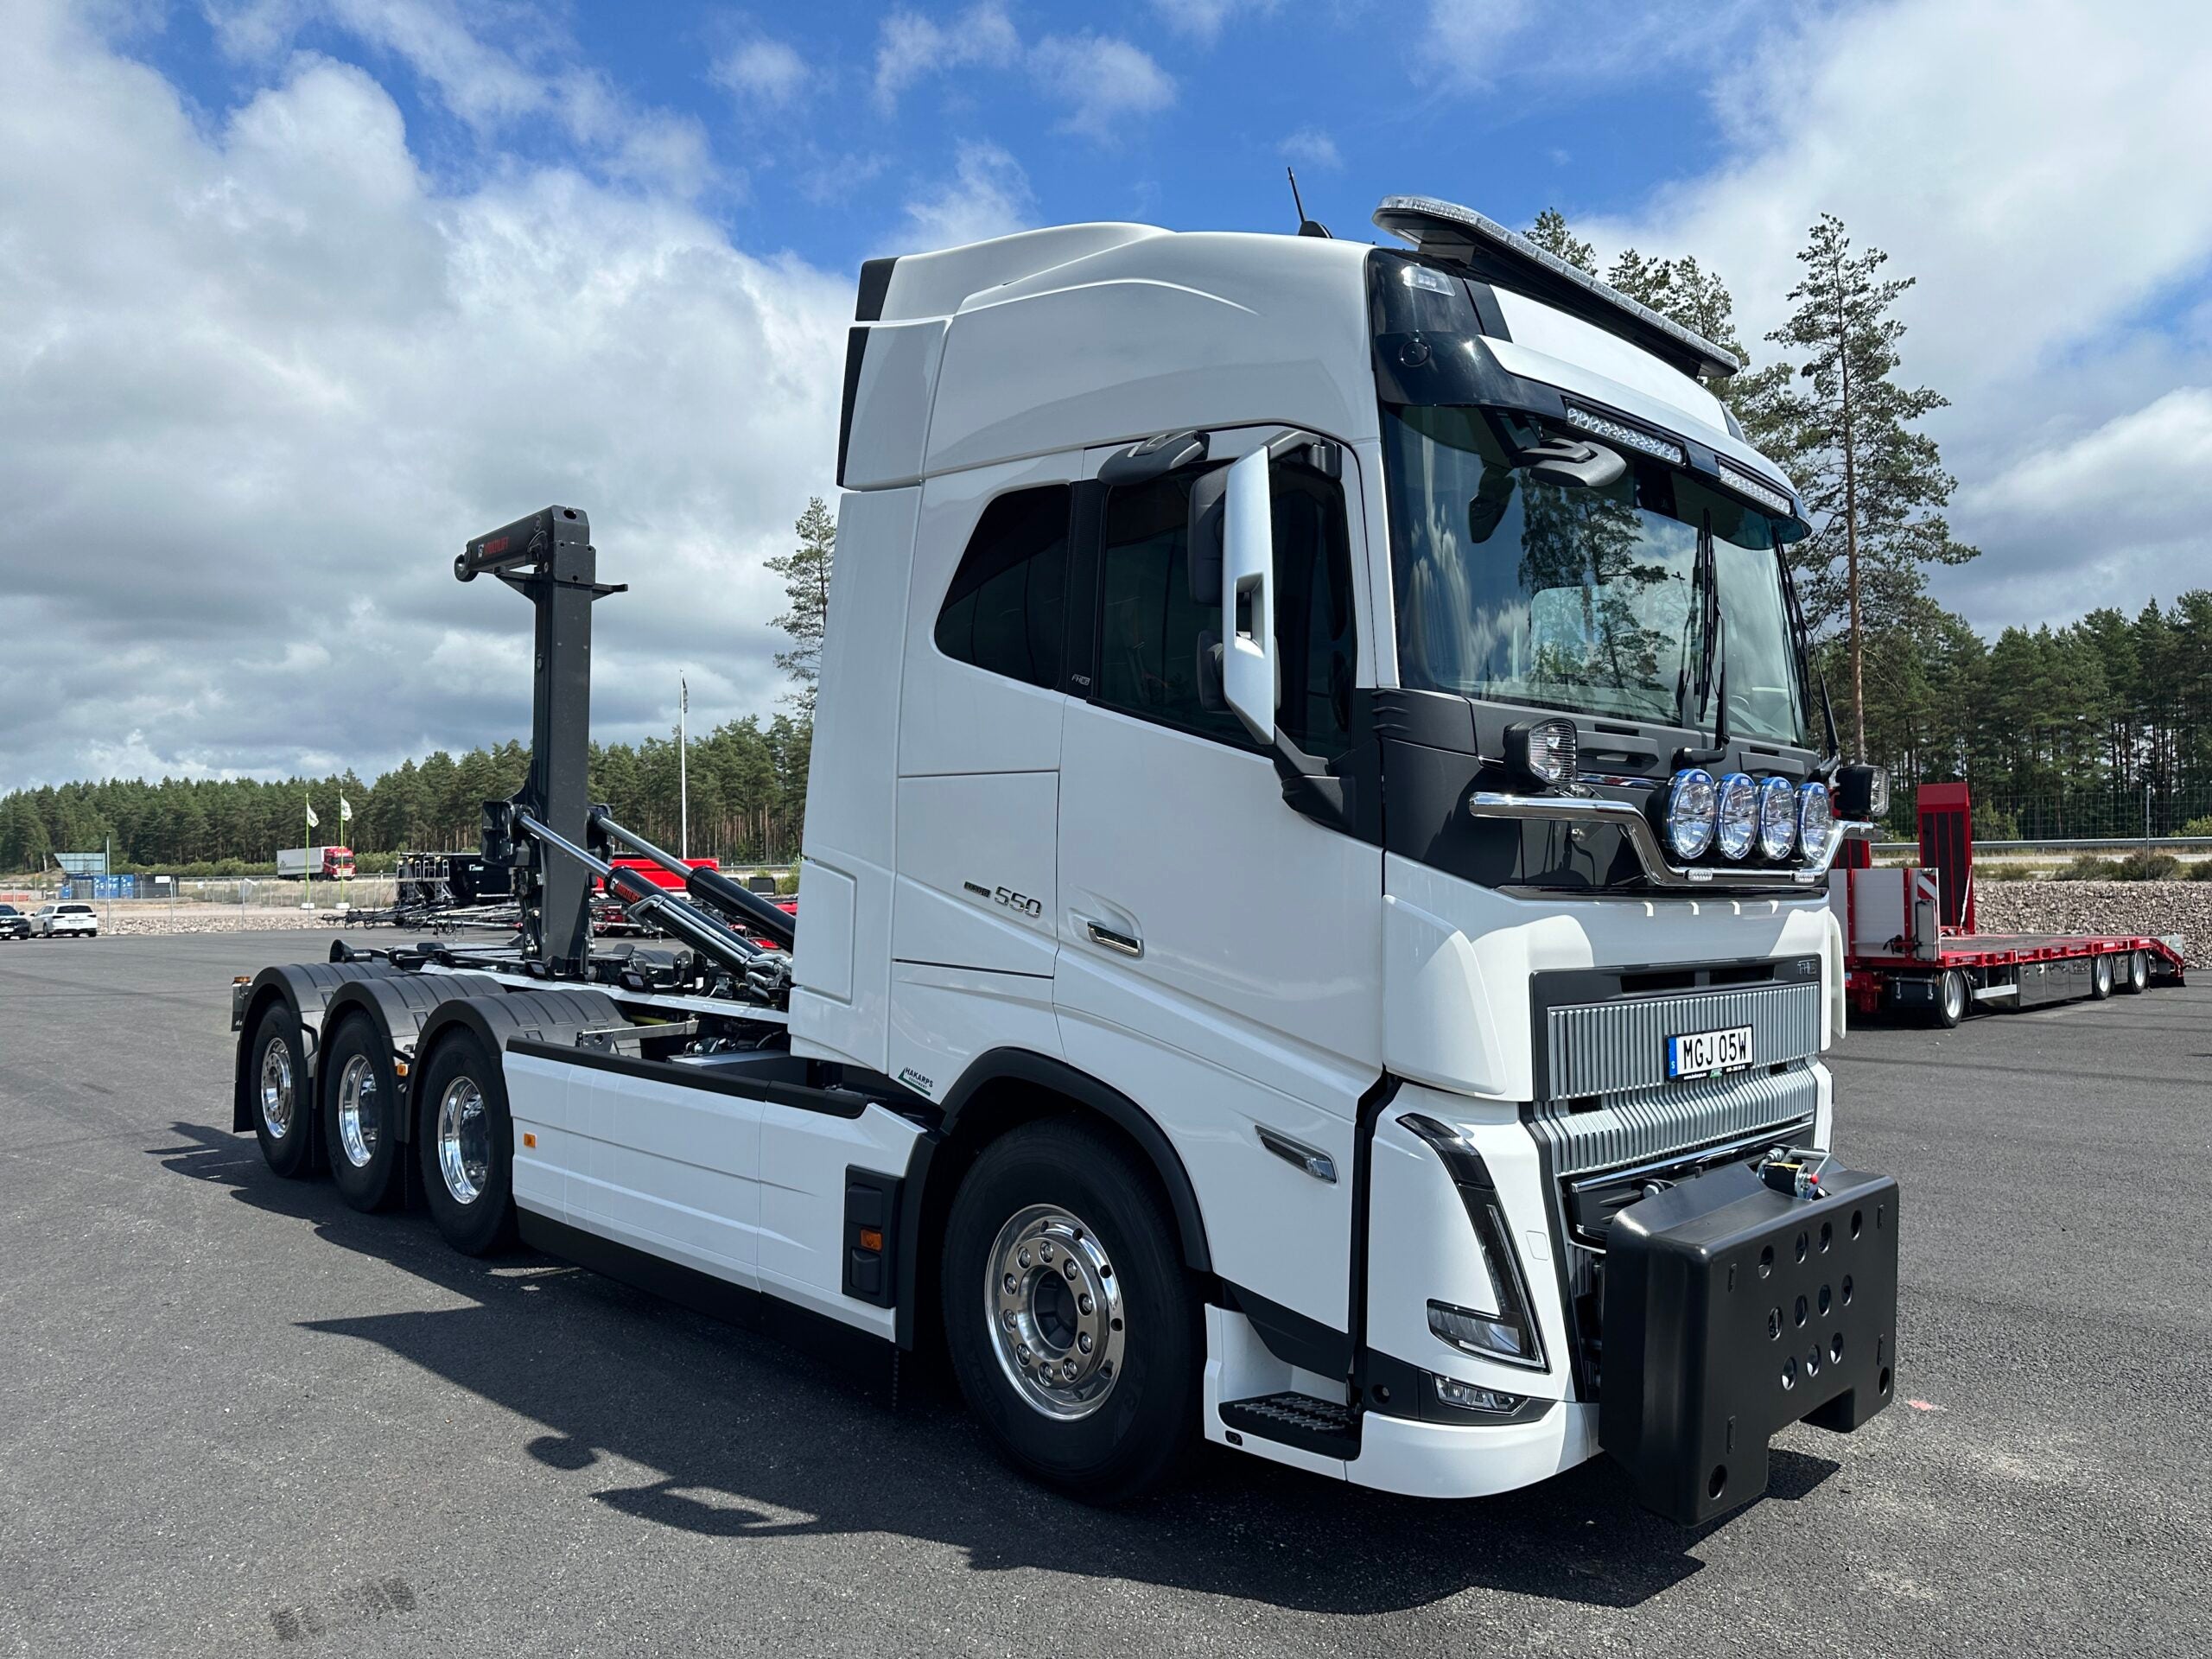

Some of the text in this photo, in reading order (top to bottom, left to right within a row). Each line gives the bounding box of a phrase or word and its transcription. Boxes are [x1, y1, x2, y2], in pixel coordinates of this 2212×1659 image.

[994, 886, 1042, 918] 550
[1683, 1031, 1747, 1070] MGJ 05W
[905, 1066, 934, 1088] HAKARPS
[1671, 1060, 1675, 1070] S
